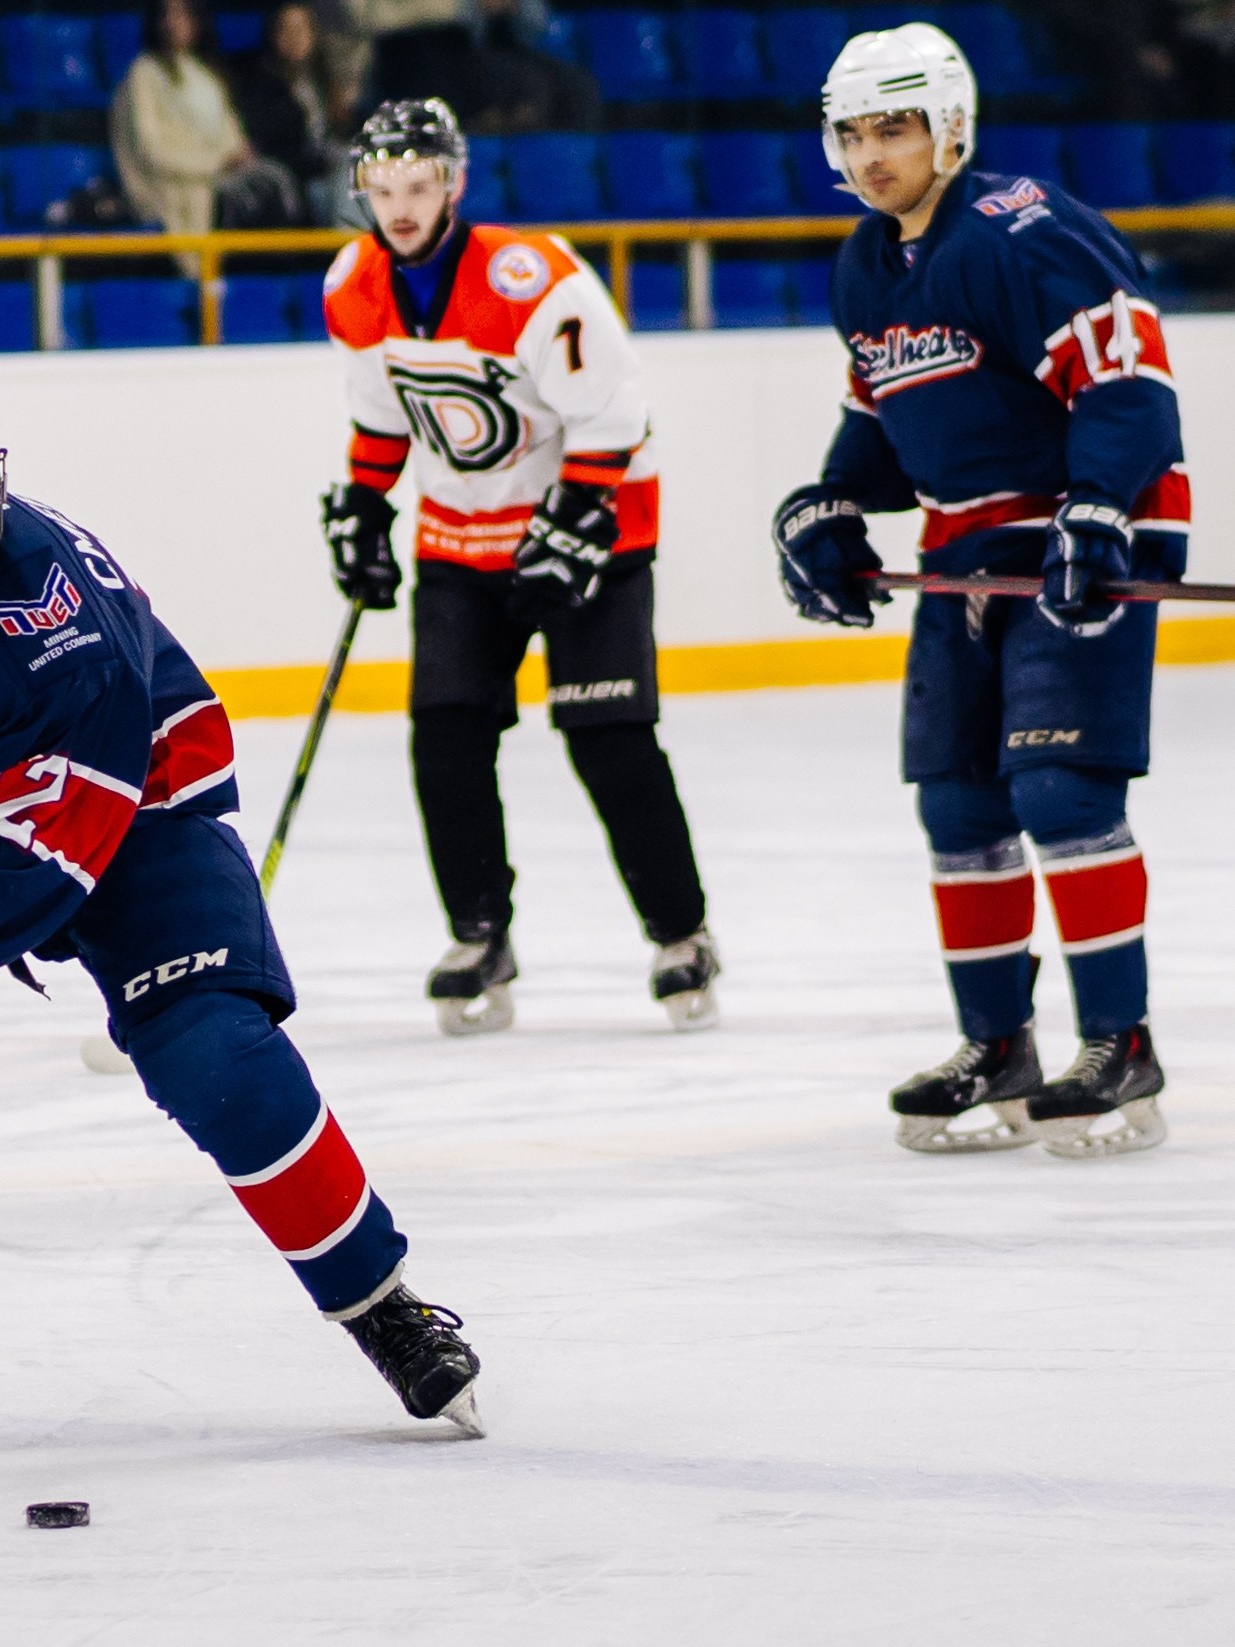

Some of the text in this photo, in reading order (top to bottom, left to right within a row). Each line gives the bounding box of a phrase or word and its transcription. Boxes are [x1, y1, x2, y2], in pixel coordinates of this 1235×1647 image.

[1071, 288, 1142, 384] 14
[528, 515, 610, 566] CCM
[784, 499, 864, 541] BAUE
[1065, 503, 1132, 539] BAU
[28, 632, 102, 672] UNITED COMPANY
[43, 626, 80, 649] MINING
[1007, 729, 1081, 749] CCM
[122, 947, 229, 1002] CCM
